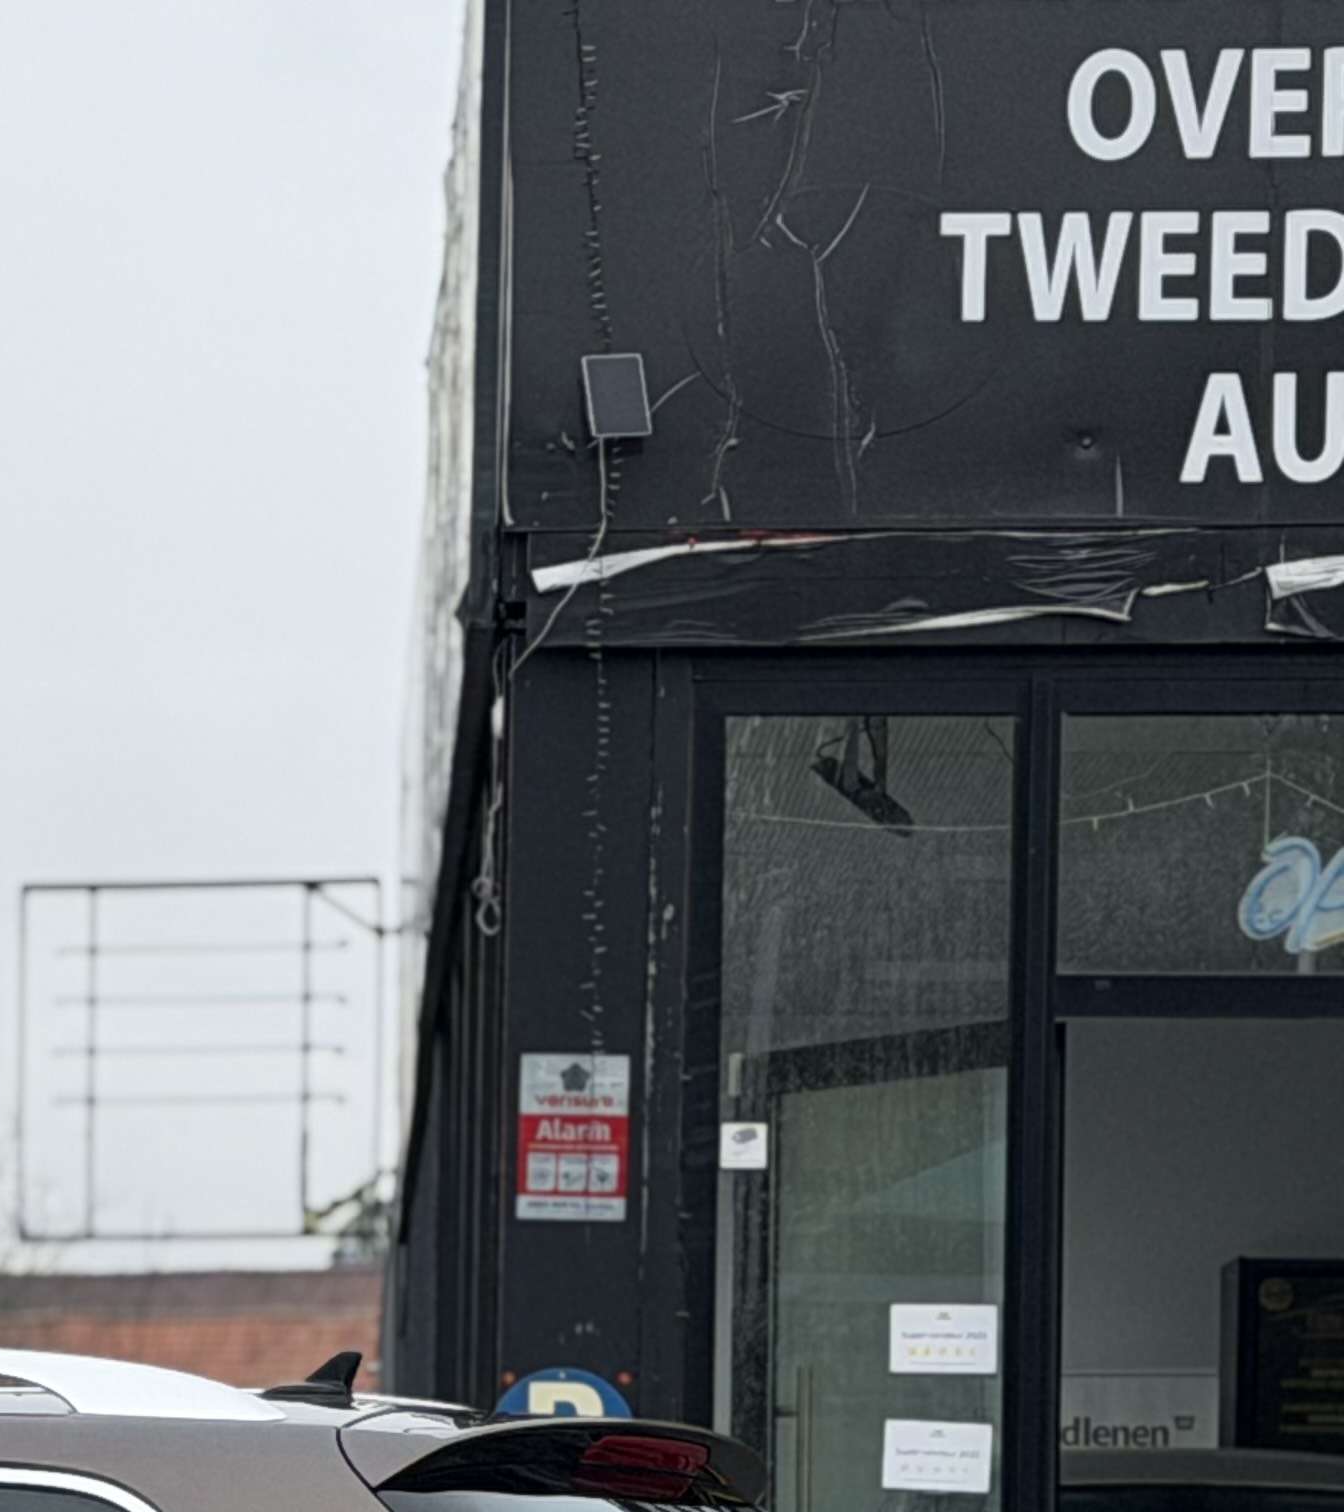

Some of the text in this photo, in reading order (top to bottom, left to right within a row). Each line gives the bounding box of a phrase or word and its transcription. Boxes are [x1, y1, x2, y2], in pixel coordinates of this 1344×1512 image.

[1067, 47, 1344, 160] OVE
[940, 209, 1344, 321] TWEED
[535, 1119, 611, 1142] Alarm
